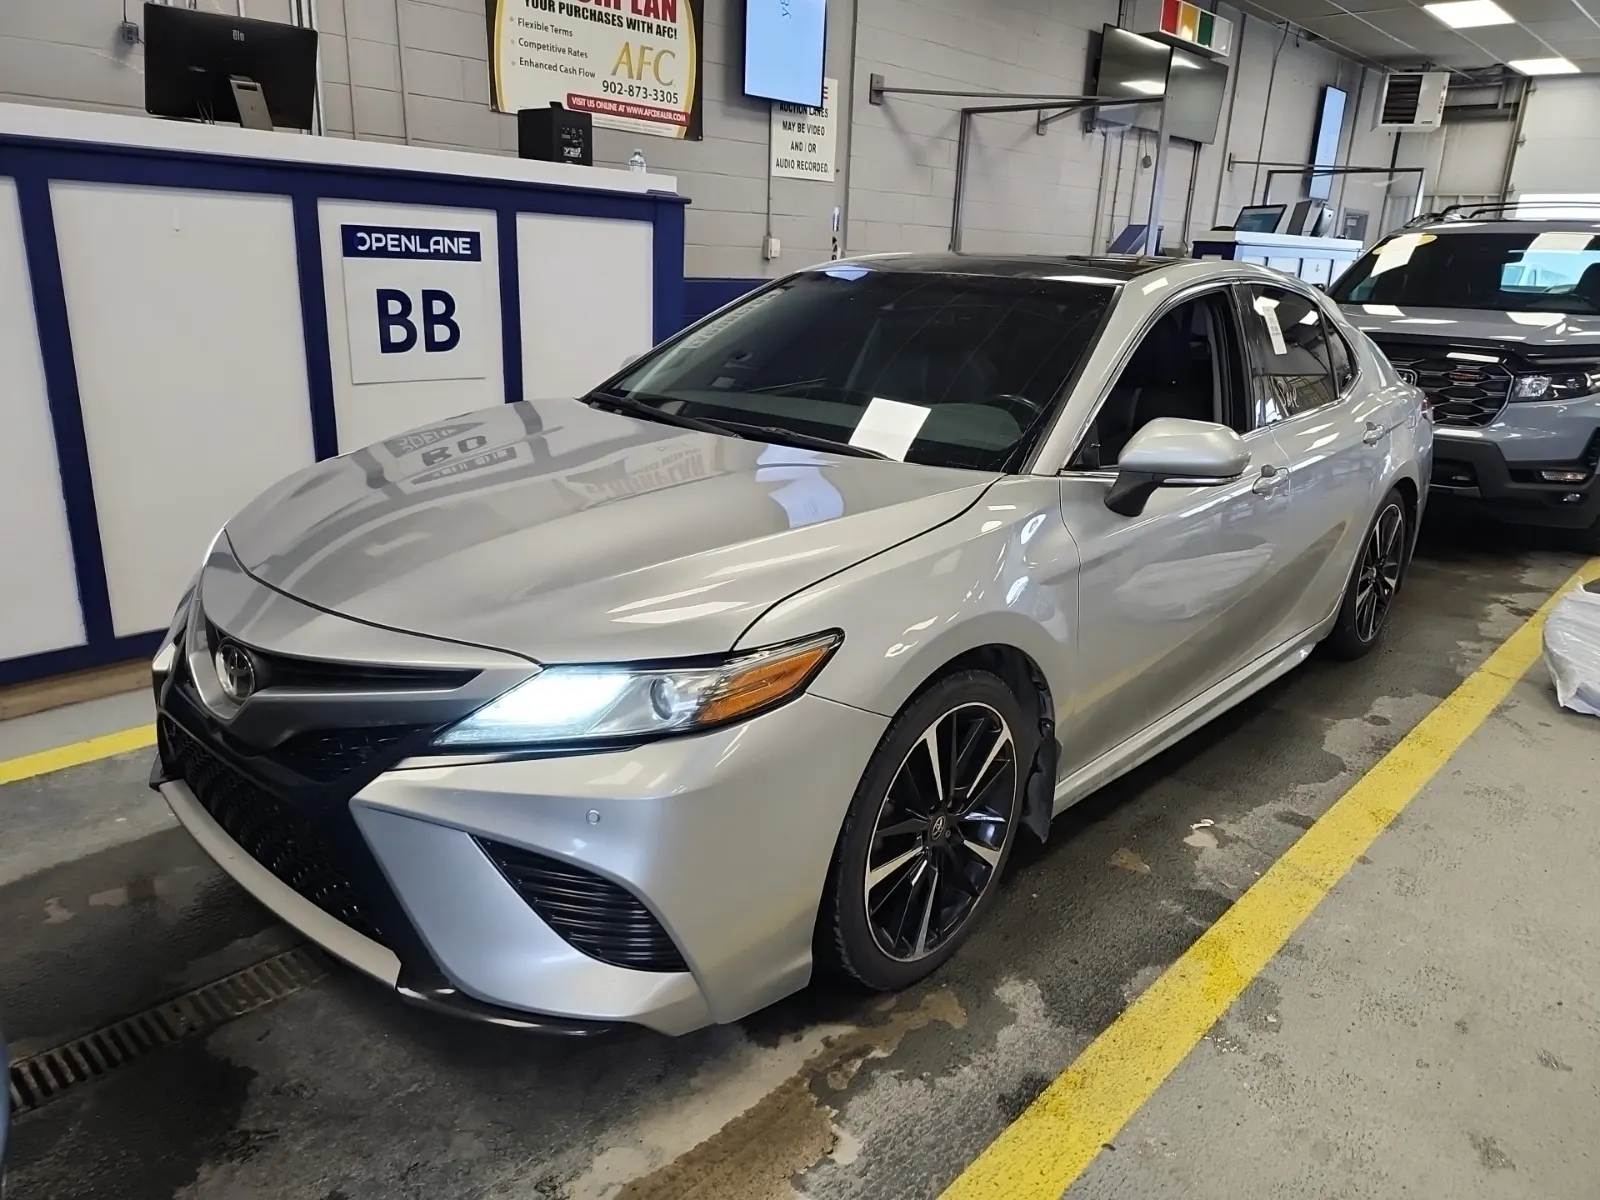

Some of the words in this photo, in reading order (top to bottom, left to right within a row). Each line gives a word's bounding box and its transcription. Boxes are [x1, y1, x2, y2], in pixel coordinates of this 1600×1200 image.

[517, 17, 549, 33] Flexible
[550, 24, 573, 37] Terms
[525, 0, 555, 13] YOUR
[558, 1, 624, 28] PURCHASES
[626, 17, 653, 34] WITH
[655, 23, 678, 40] AFC!
[518, 37, 566, 55] Competitive
[567, 47, 588, 59] Rates
[519, 56, 558, 72] Enhanced
[559, 64, 577, 76] Cash
[578, 67, 596, 79] Flow
[611, 41, 677, 87] AFC
[602, 80, 679, 104] 902-873-3305
[571, 96, 586, 107] VISIT
[586, 99, 596, 108] US
[596, 101, 617, 111] ONLINE
[618, 104, 627, 112] AT
[626, 106, 686, 123] WWW.AFCDEALER.COM
[780, 102, 807, 115] AUCTION
[782, 120, 796, 132] MAY
[797, 122, 805, 134] BE
[807, 124, 825, 136] VIDEO
[790, 140, 803, 152] AND
[807, 143, 817, 154] OR
[775, 158, 795, 170] AUDIO
[796, 160, 830, 173] RECORDED.
[376, 288, 461, 353] BB
